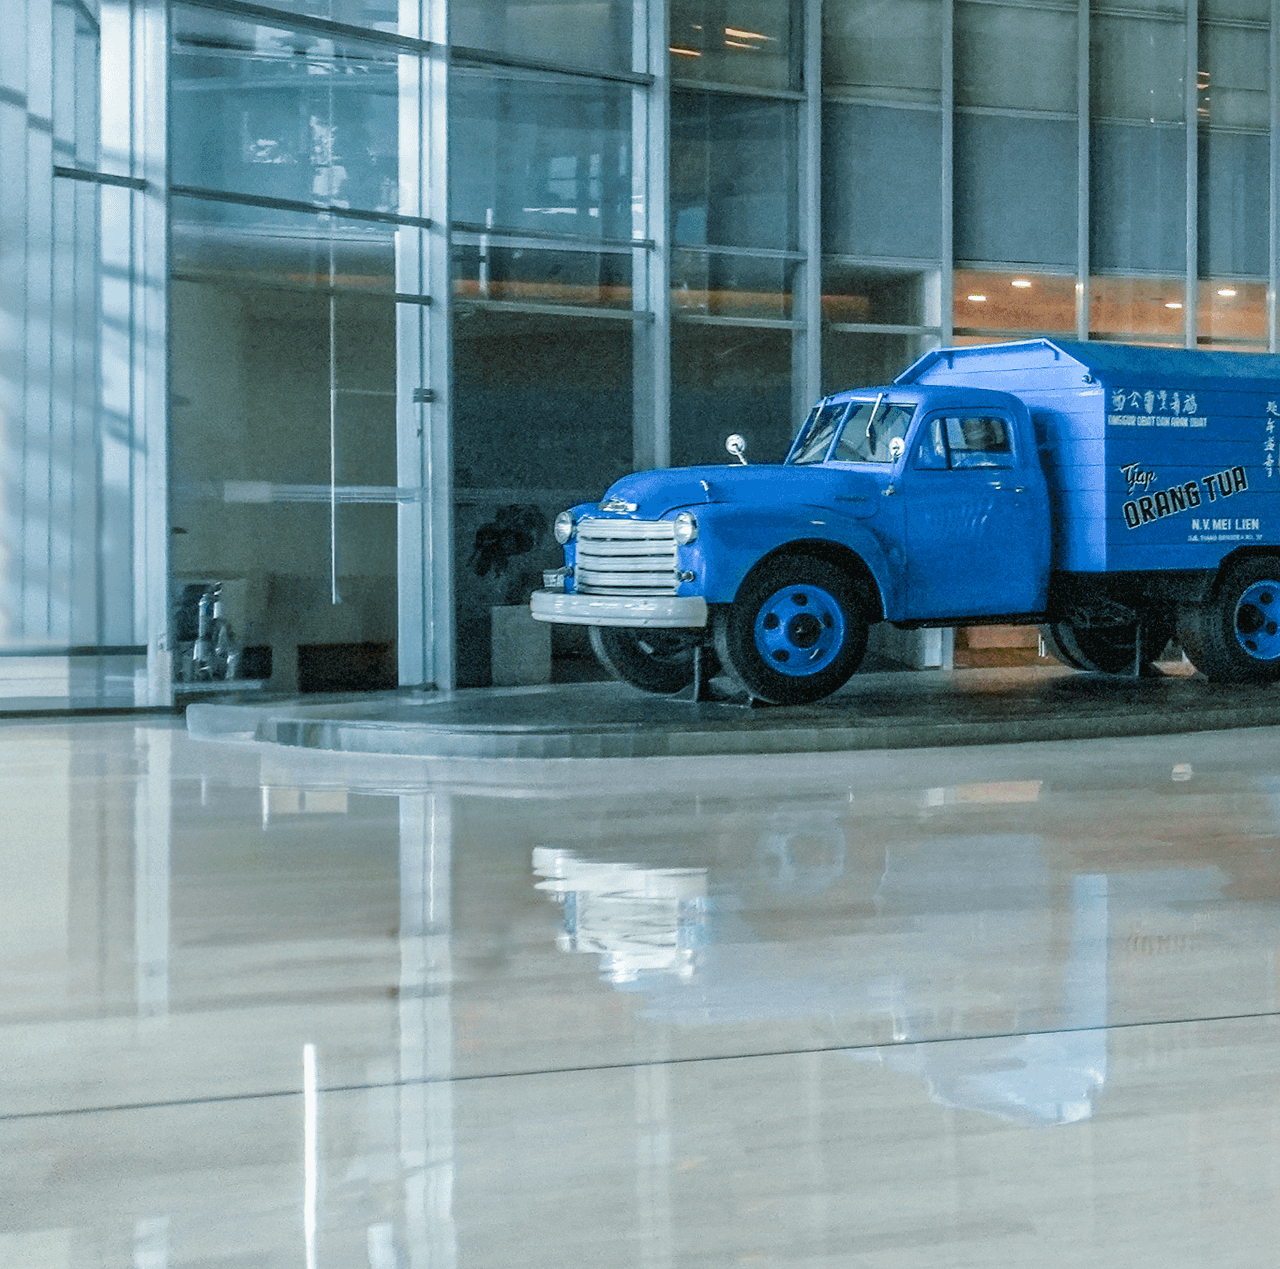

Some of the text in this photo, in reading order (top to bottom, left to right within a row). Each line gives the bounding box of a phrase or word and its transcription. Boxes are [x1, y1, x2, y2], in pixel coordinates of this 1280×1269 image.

[1119, 461, 1158, 496] Tjap
[1122, 465, 1248, 530] ORANG TUA
[1212, 519, 1231, 530] MEI
[1235, 519, 1259, 530] LIEN
